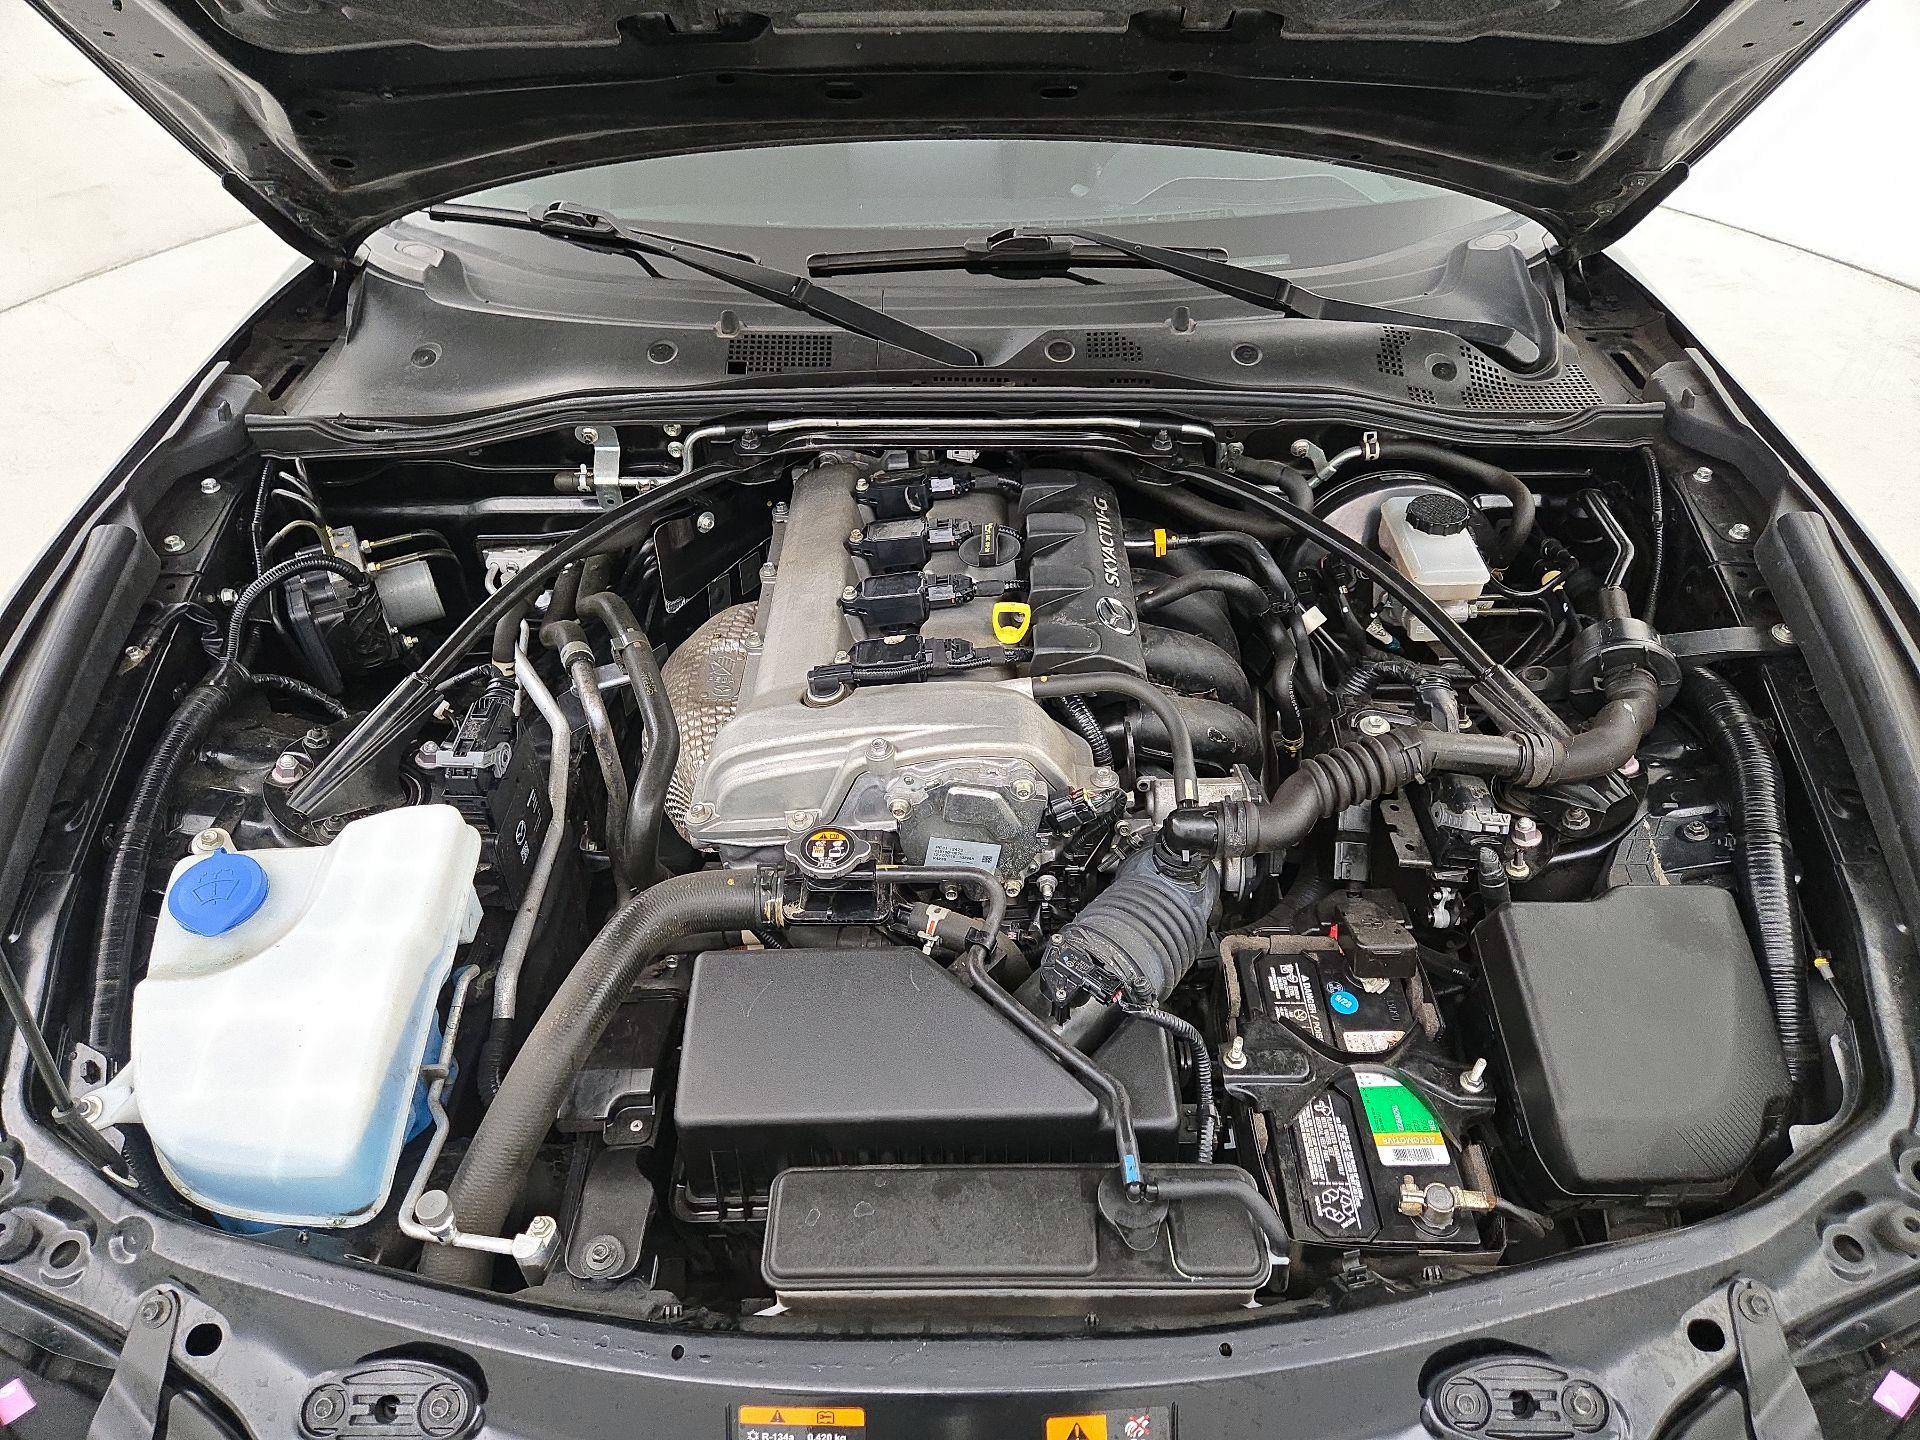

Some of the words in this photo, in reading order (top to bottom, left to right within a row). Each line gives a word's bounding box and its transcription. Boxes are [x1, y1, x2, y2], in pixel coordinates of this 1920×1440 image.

[1093, 496, 1121, 588] SKYACTIV-G
[1302, 983, 1317, 1014] DANGER
[1312, 1021, 1325, 1042] POIS
[1383, 1136, 1436, 1144] AUTOMOTIVE
